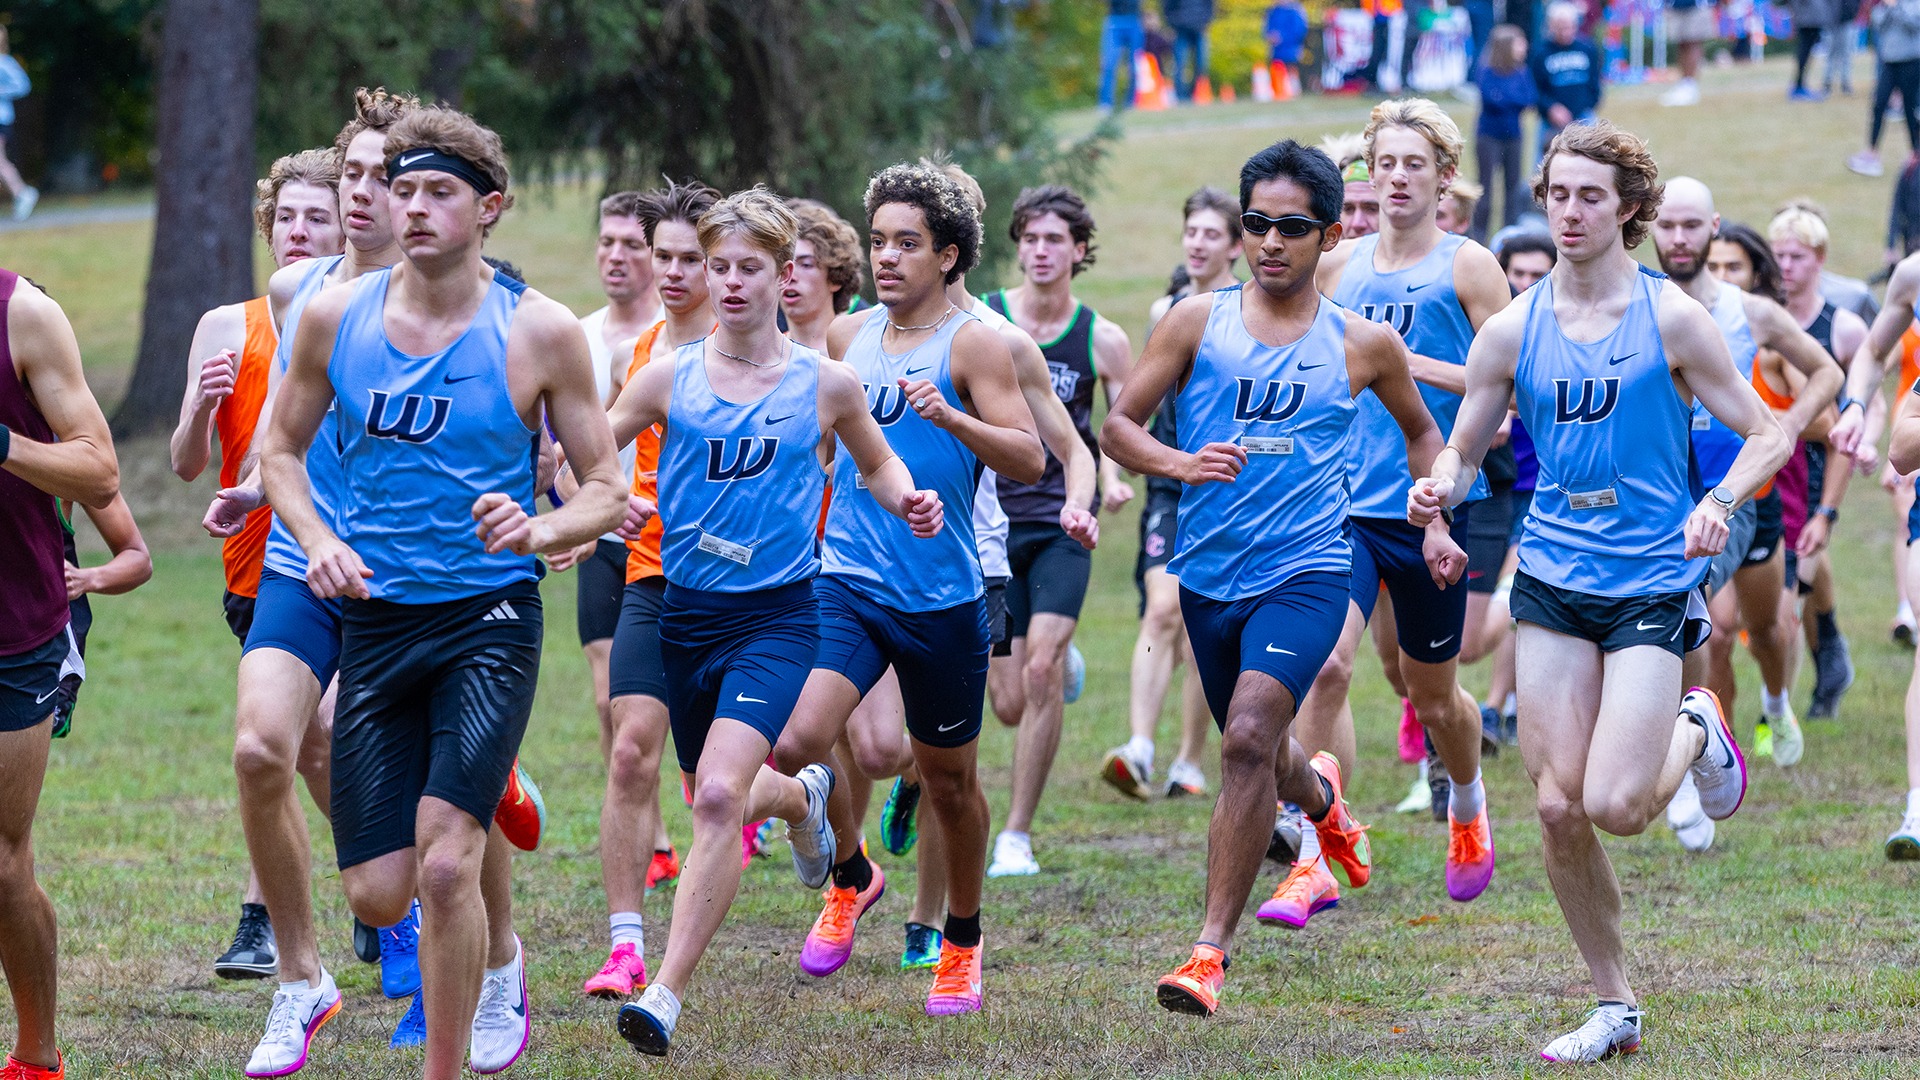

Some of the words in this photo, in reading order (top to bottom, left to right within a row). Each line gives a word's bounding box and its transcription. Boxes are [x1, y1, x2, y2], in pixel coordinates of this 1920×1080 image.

[365, 388, 454, 445] W
[1233, 376, 1308, 423] W
[1551, 376, 1621, 424] W
[703, 436, 781, 483] W
